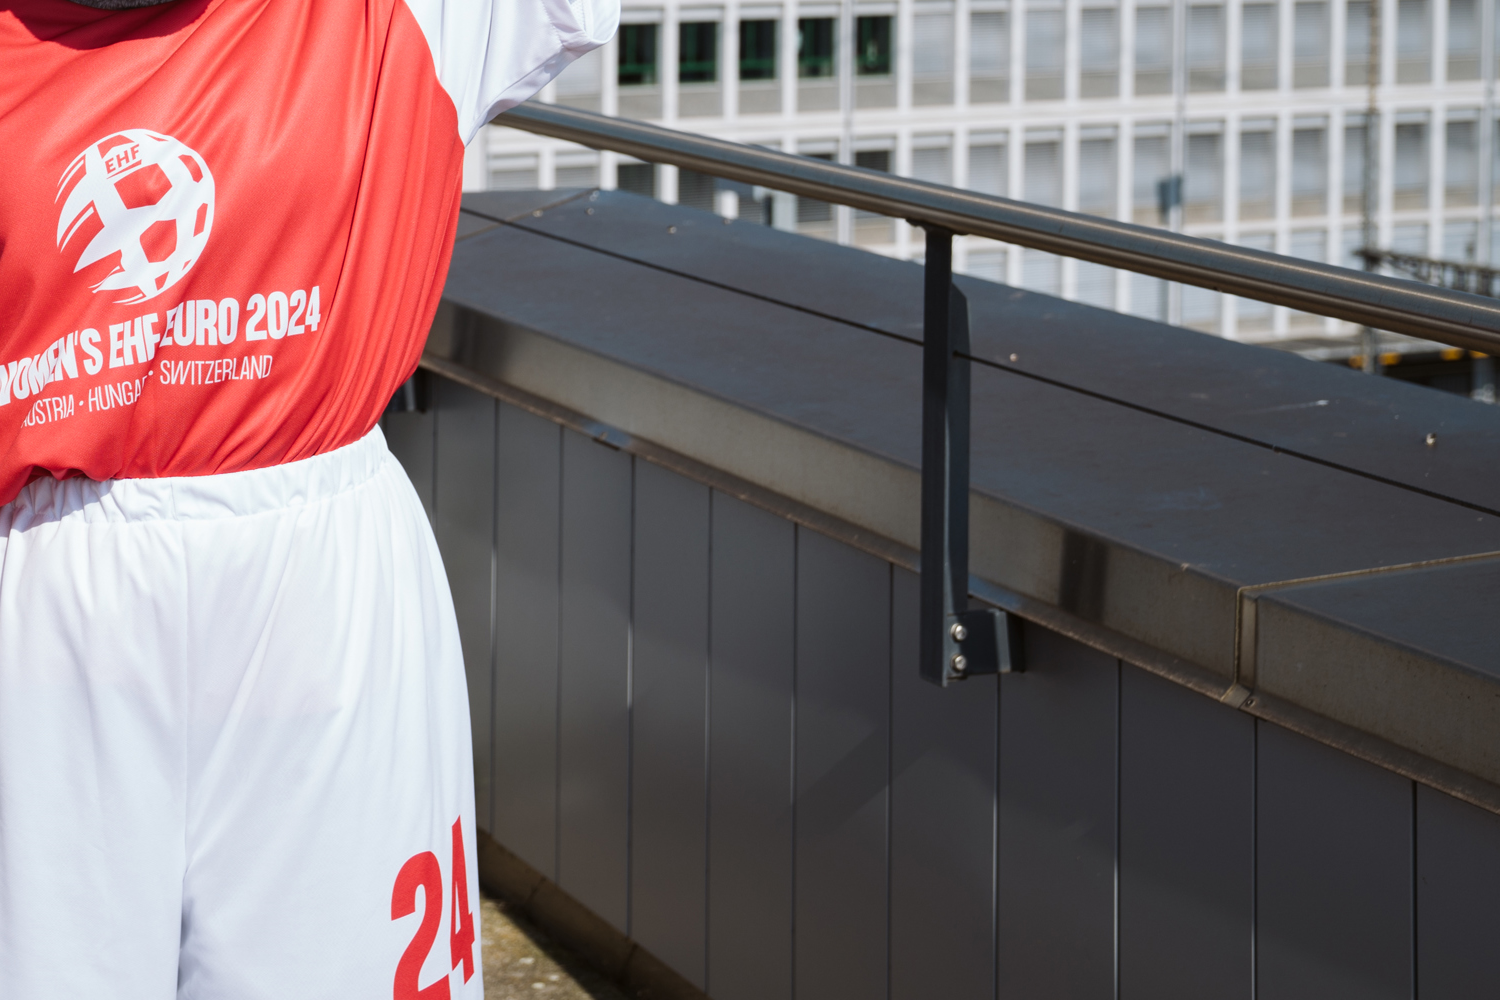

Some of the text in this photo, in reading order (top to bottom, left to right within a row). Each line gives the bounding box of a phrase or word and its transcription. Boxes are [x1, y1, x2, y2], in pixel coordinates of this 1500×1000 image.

[105, 143, 140, 174] EHF
[109, 312, 161, 369] EHF
[159, 297, 240, 348] EURO
[245, 285, 322, 342] 2024
[160, 354, 273, 385] SWITZERLAND
[391, 814, 475, 1000] 24
